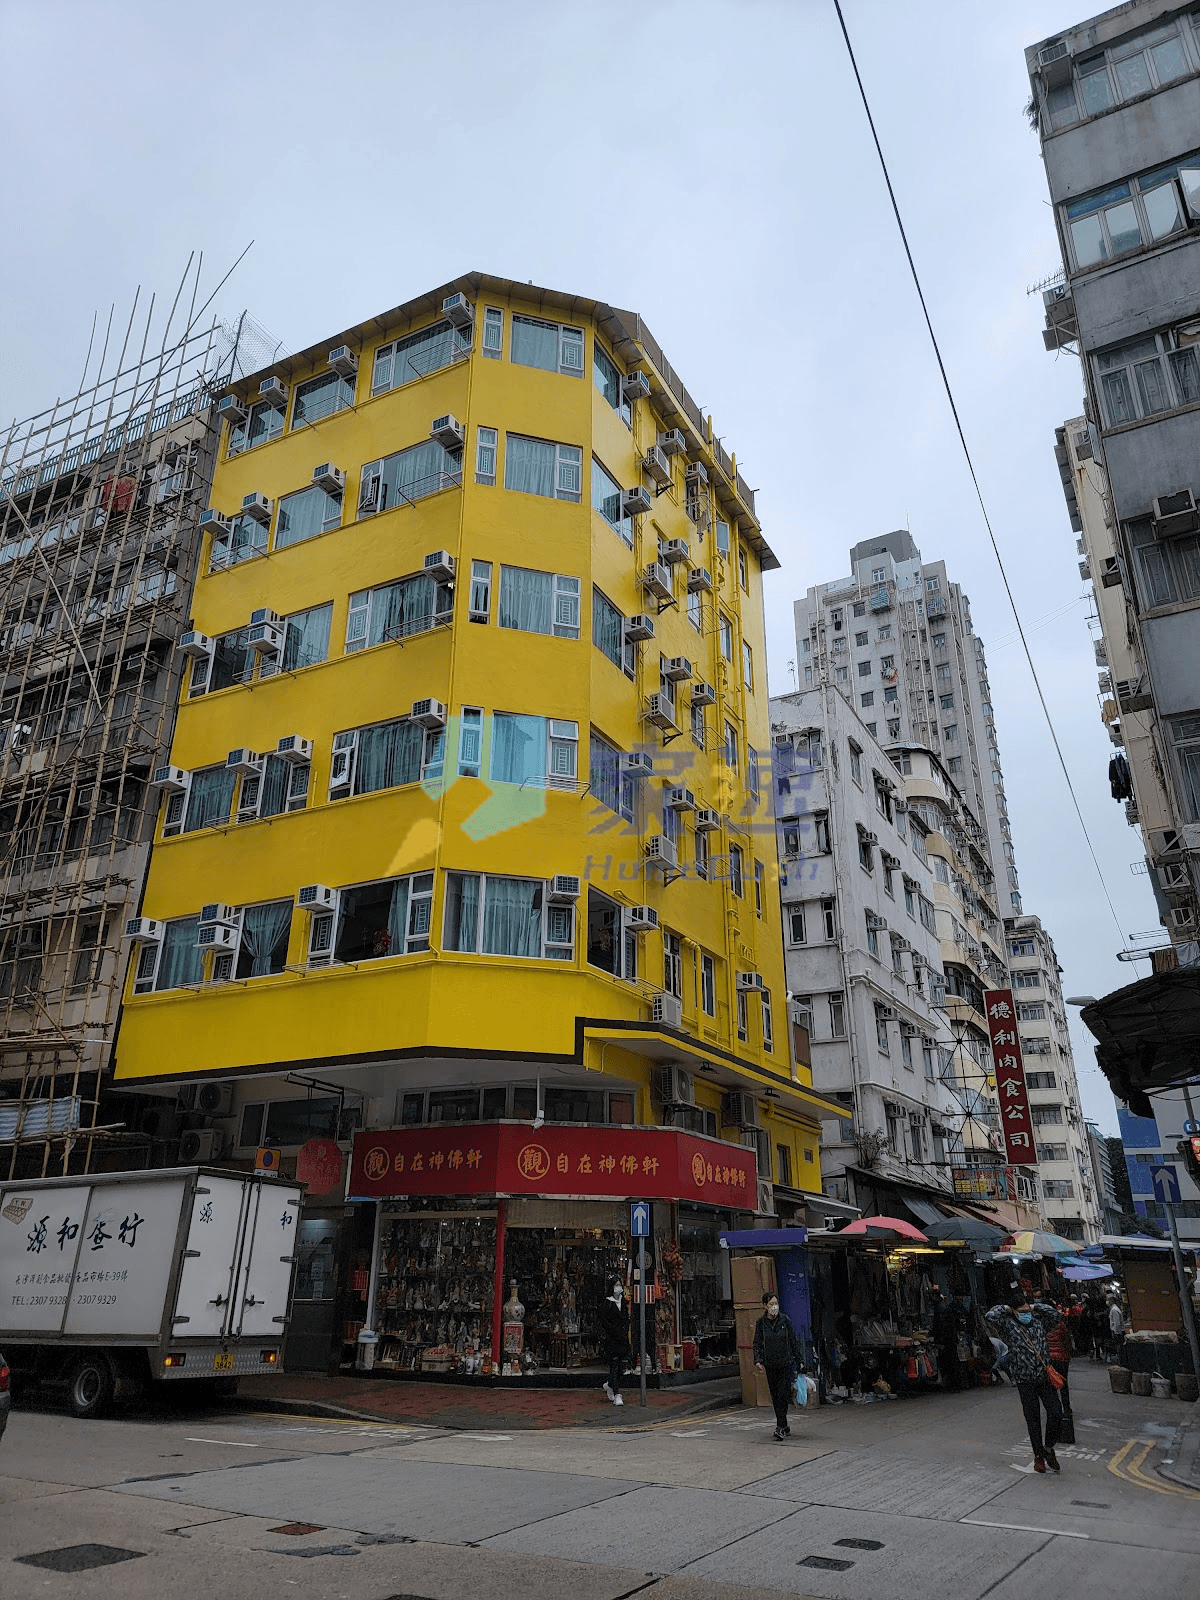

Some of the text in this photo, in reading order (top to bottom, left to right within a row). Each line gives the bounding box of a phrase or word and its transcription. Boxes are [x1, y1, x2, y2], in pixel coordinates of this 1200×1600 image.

[989, 1001, 1030, 1148] 德利肉食公司
[367, 1148, 483, 1176] 觀 自在神佛軒
[522, 1148, 660, 1177] 觀 自在神佛軒
[706, 1161, 747, 1188] 自在神佛軒
[280, 1210, 294, 1231] 和
